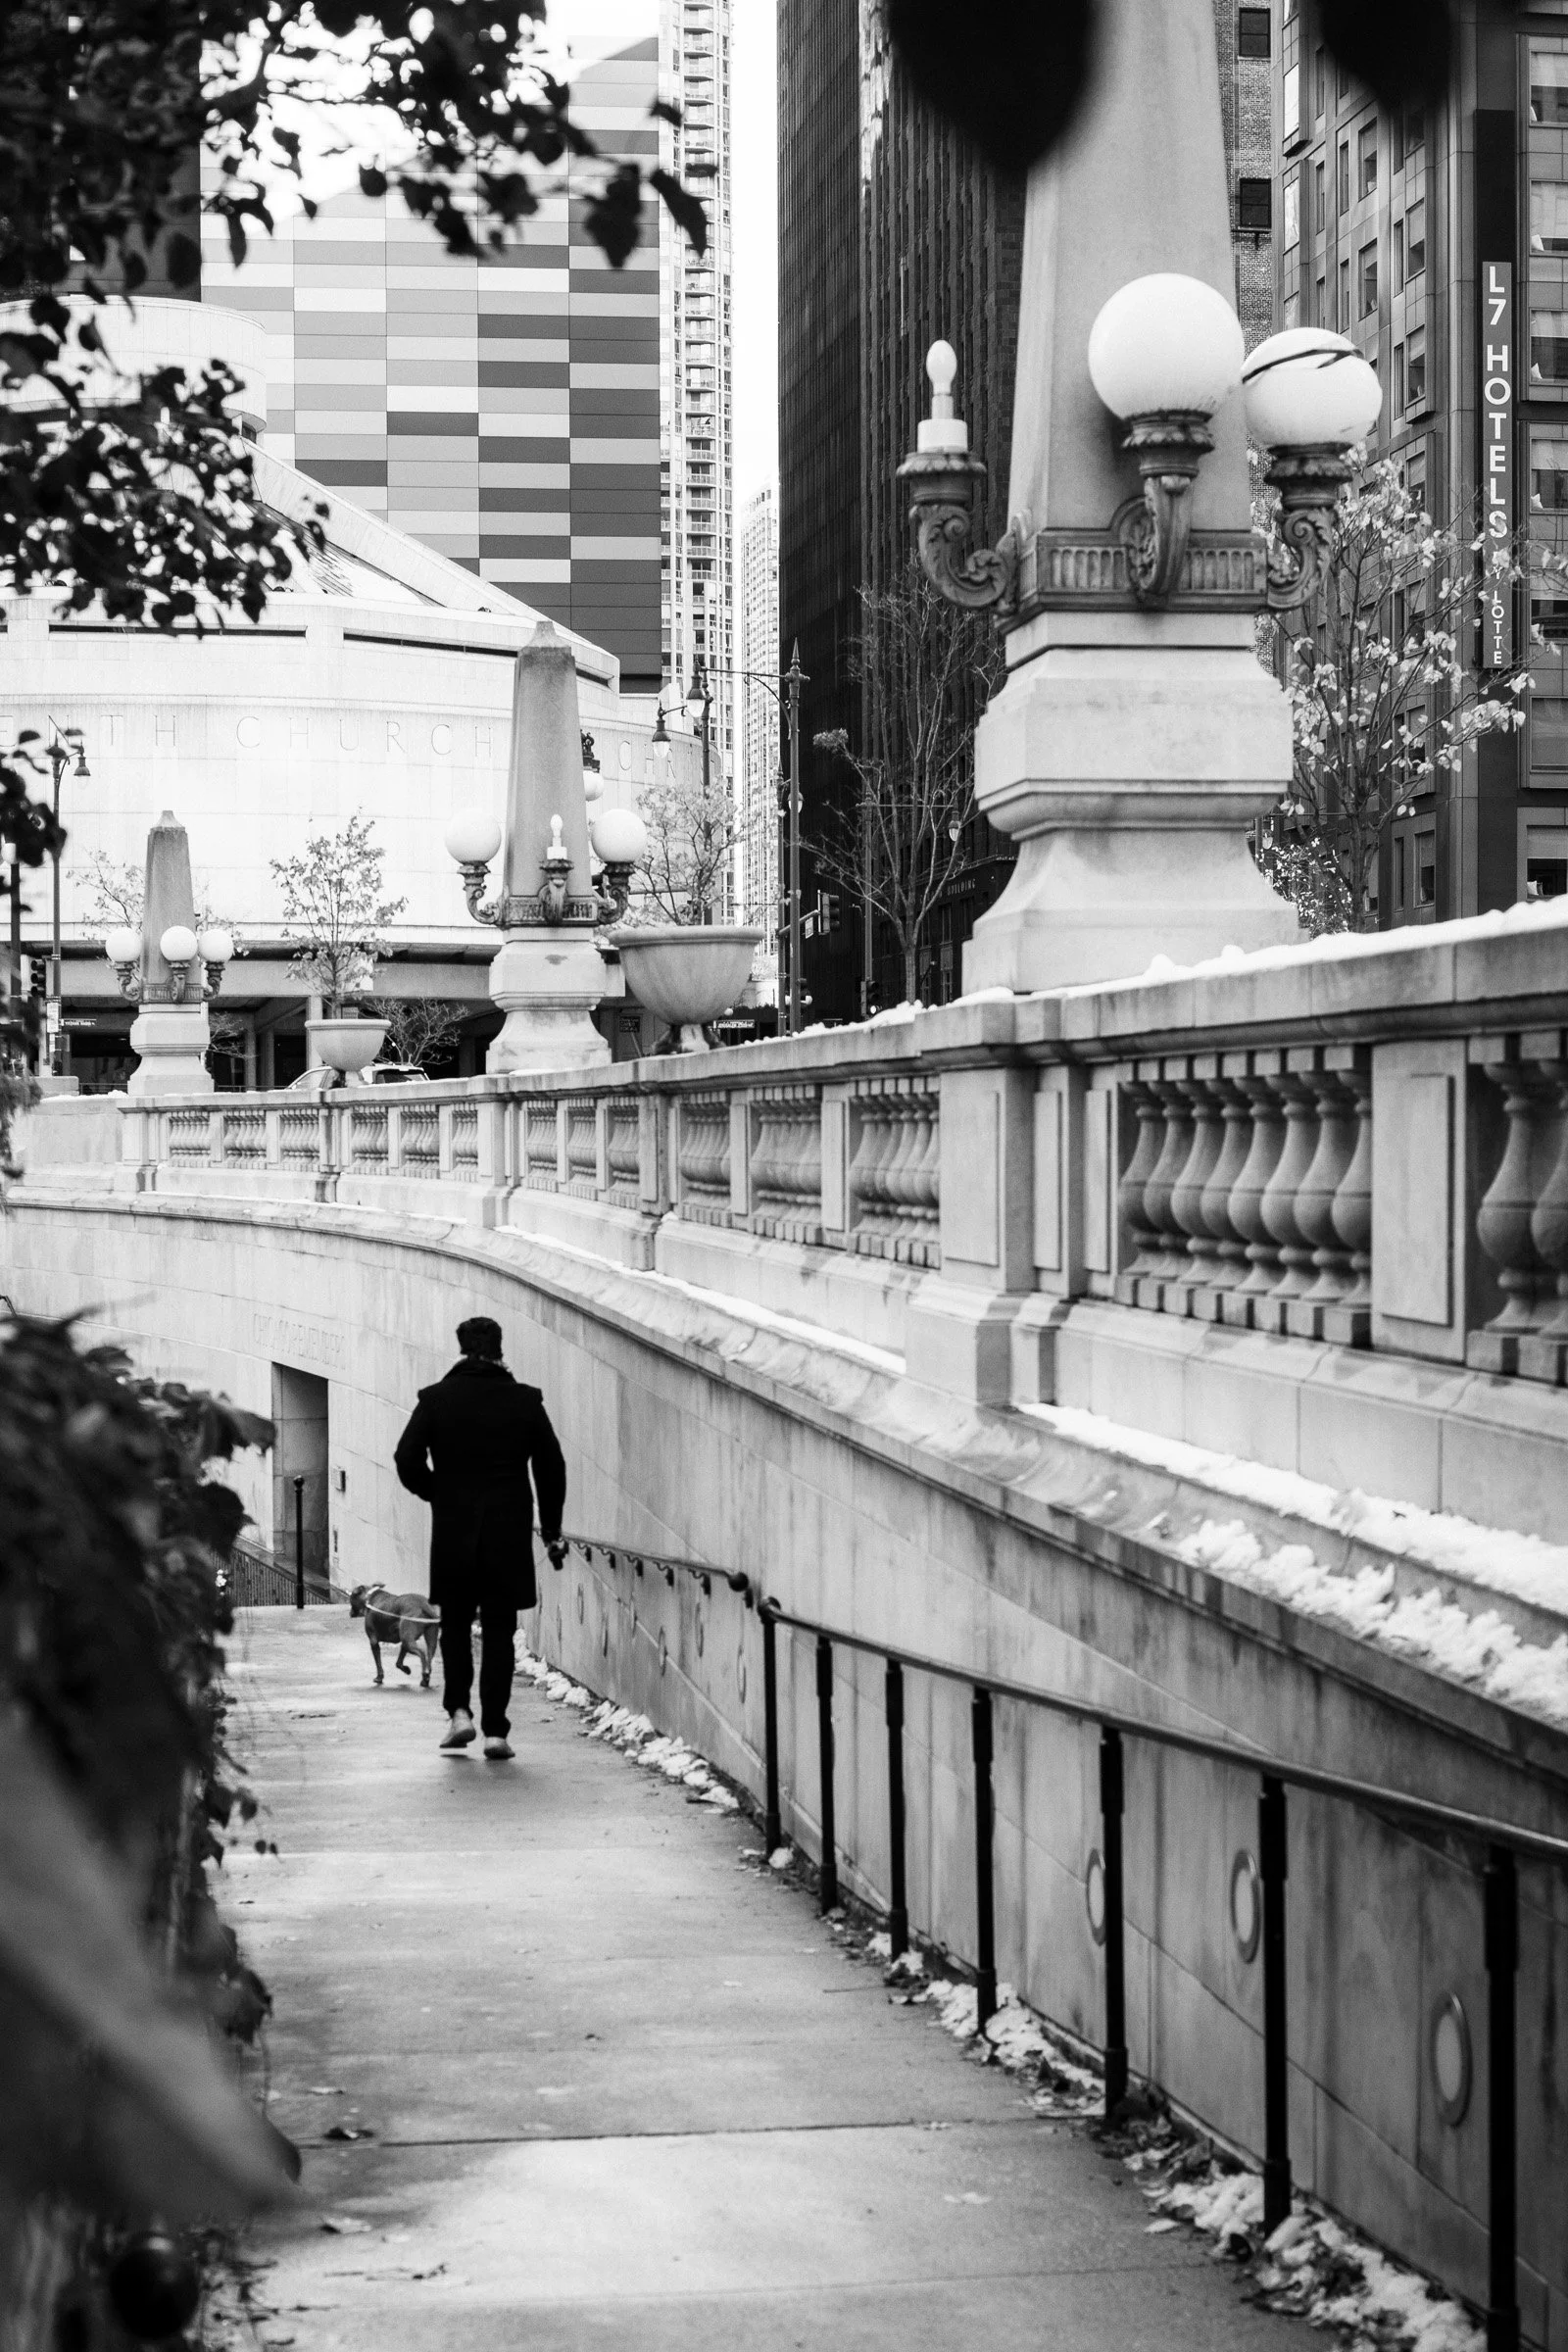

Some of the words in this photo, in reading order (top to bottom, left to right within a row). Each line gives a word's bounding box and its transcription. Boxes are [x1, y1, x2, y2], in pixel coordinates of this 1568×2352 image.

[1488, 266, 1507, 325] L7
[1484, 344, 1511, 538] HOTELS
[1491, 590, 1505, 664] LOTTE
[236, 715, 492, 758] CHURCH
